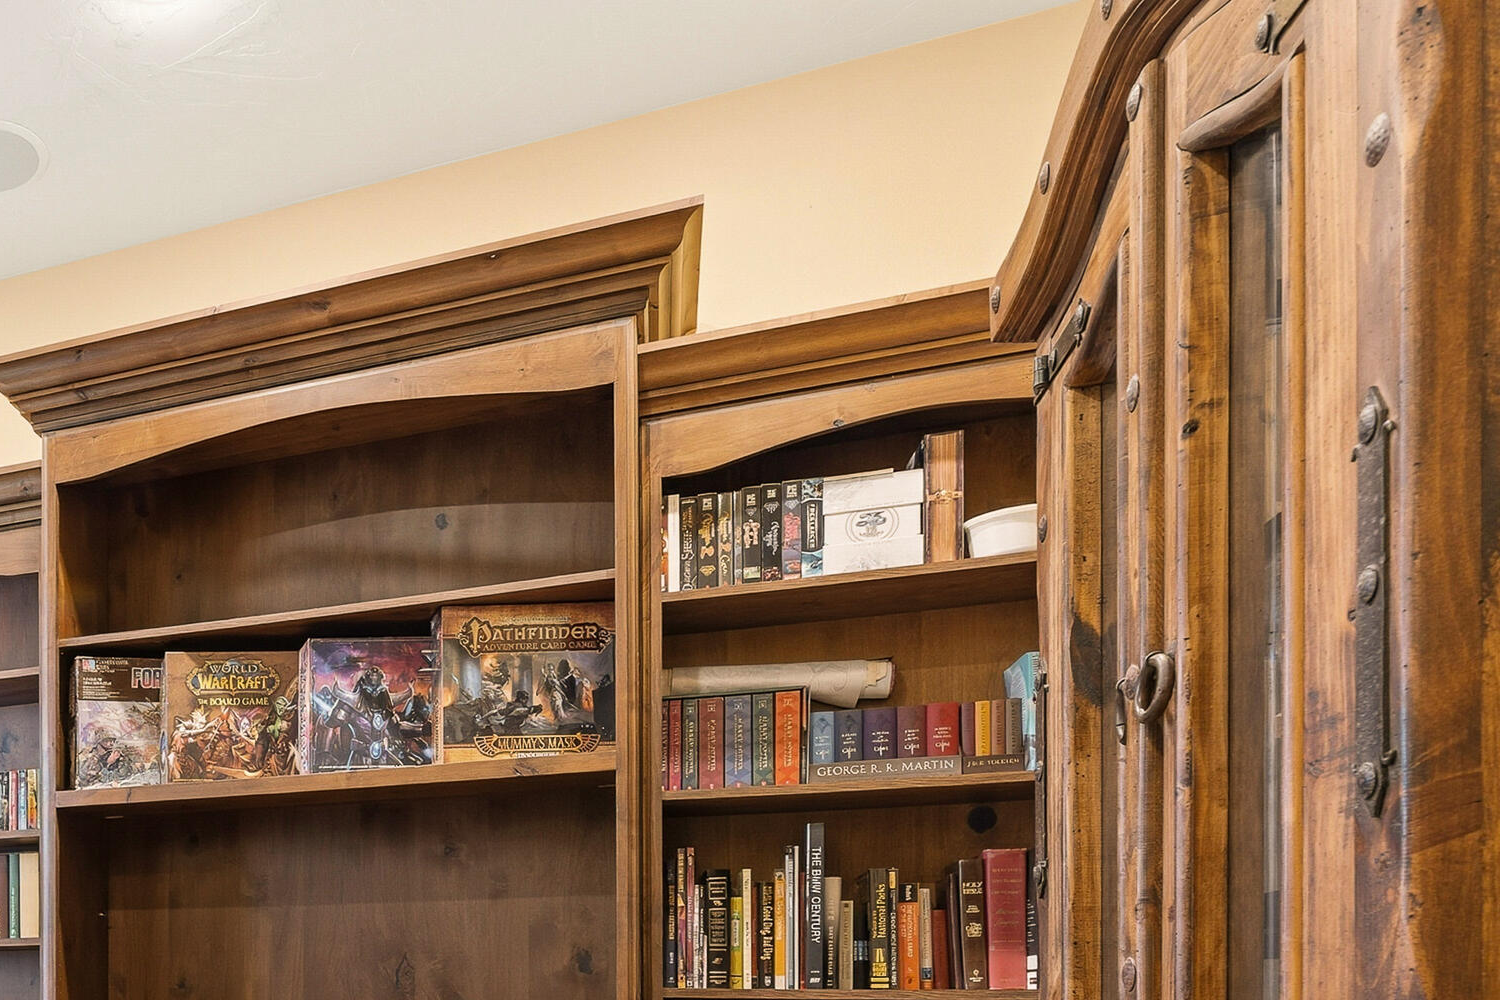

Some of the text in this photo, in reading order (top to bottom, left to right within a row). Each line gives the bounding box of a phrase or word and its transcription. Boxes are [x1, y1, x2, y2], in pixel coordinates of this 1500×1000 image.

[469, 619, 597, 653] PATHFINDER
[482, 641, 538, 652] ADVENTURE
[540, 641, 566, 651] CARD
[209, 663, 258, 674] WORLD
[209, 697, 240, 706] BOARD
[242, 697, 269, 706] GAME
[545, 736, 577, 750] MASK
[817, 760, 954, 777] GEORGE R. R. MARTIN
[811, 846, 822, 944] THE BMW CENTURY
